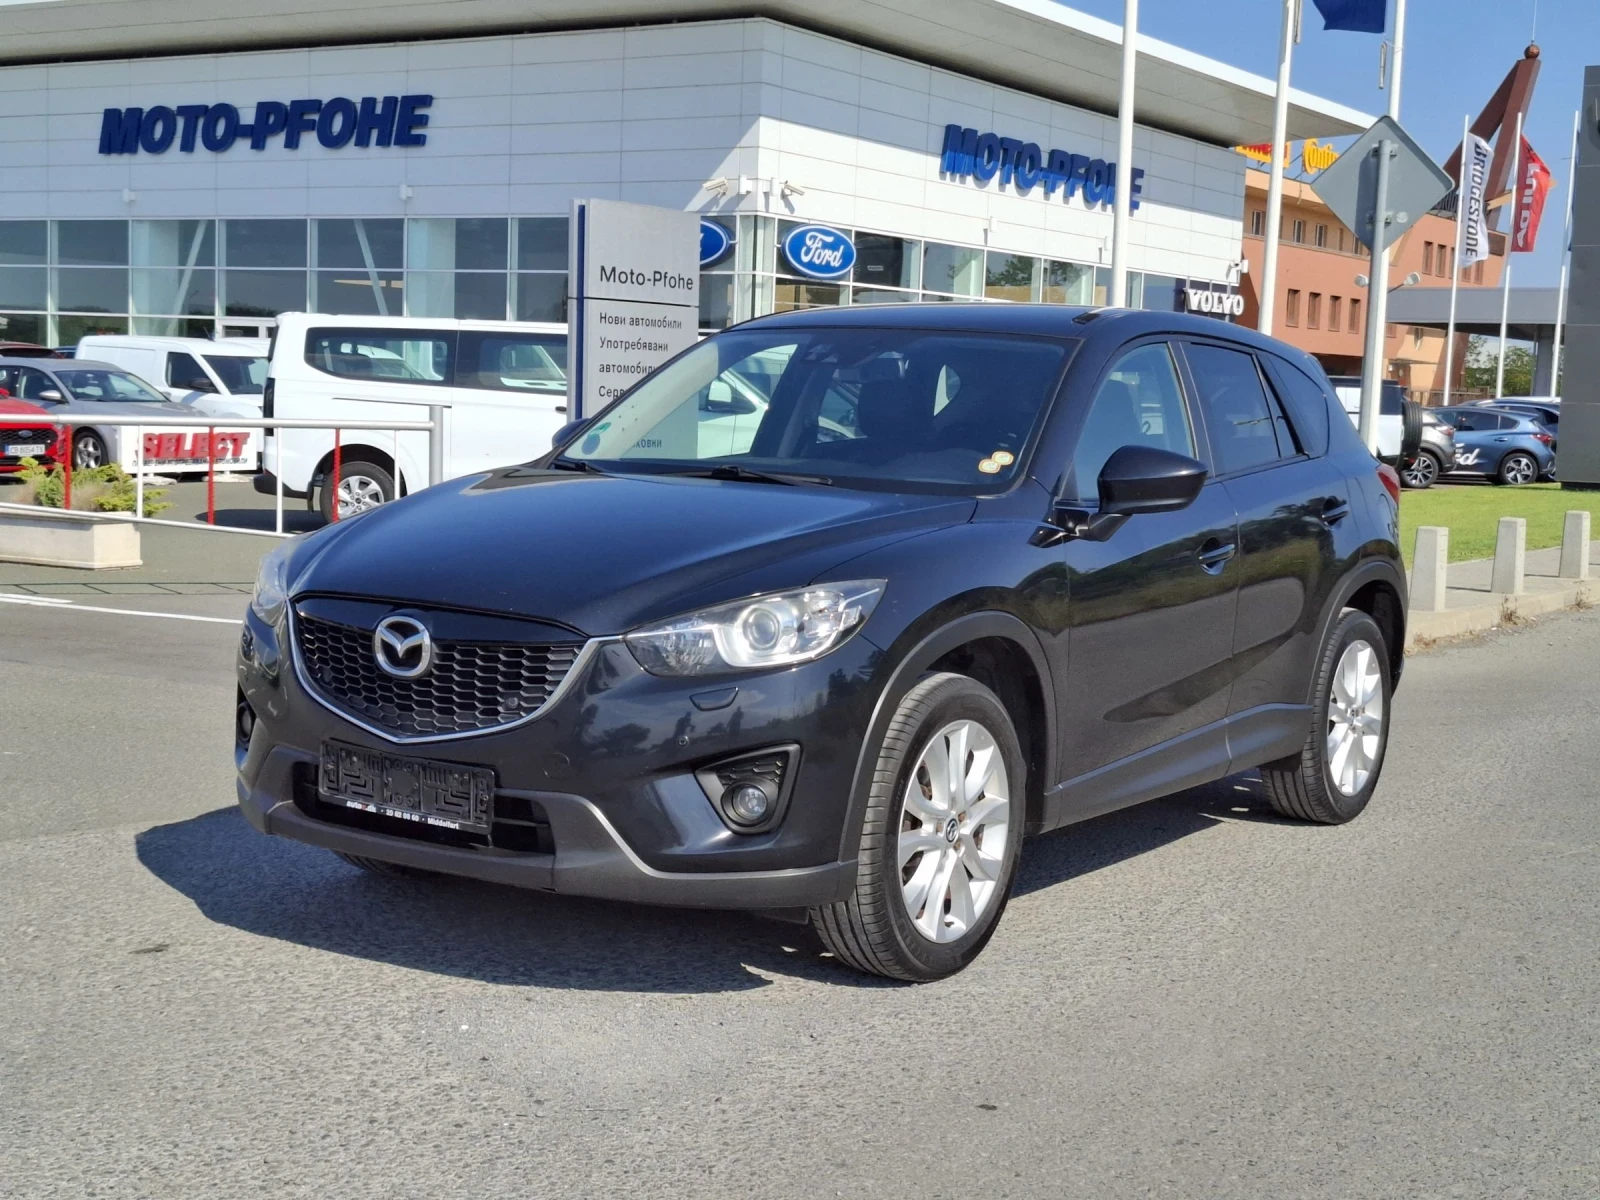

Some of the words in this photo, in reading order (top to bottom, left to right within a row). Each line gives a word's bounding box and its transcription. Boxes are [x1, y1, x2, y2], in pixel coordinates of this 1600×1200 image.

[98, 94, 433, 155] MOTO-PFOHE
[1466, 141, 1488, 258] BRIDGESTONE
[801, 231, 844, 268] Ford
[600, 265, 694, 290] Moto-Pfohe
[1187, 288, 1245, 316] VOLVO
[599, 312, 626, 326] Нови
[628, 315, 682, 329] автомобили
[599, 337, 669, 353] Употребявани
[599, 361, 656, 375] автомобил
[134, 432, 251, 459] SELECT
